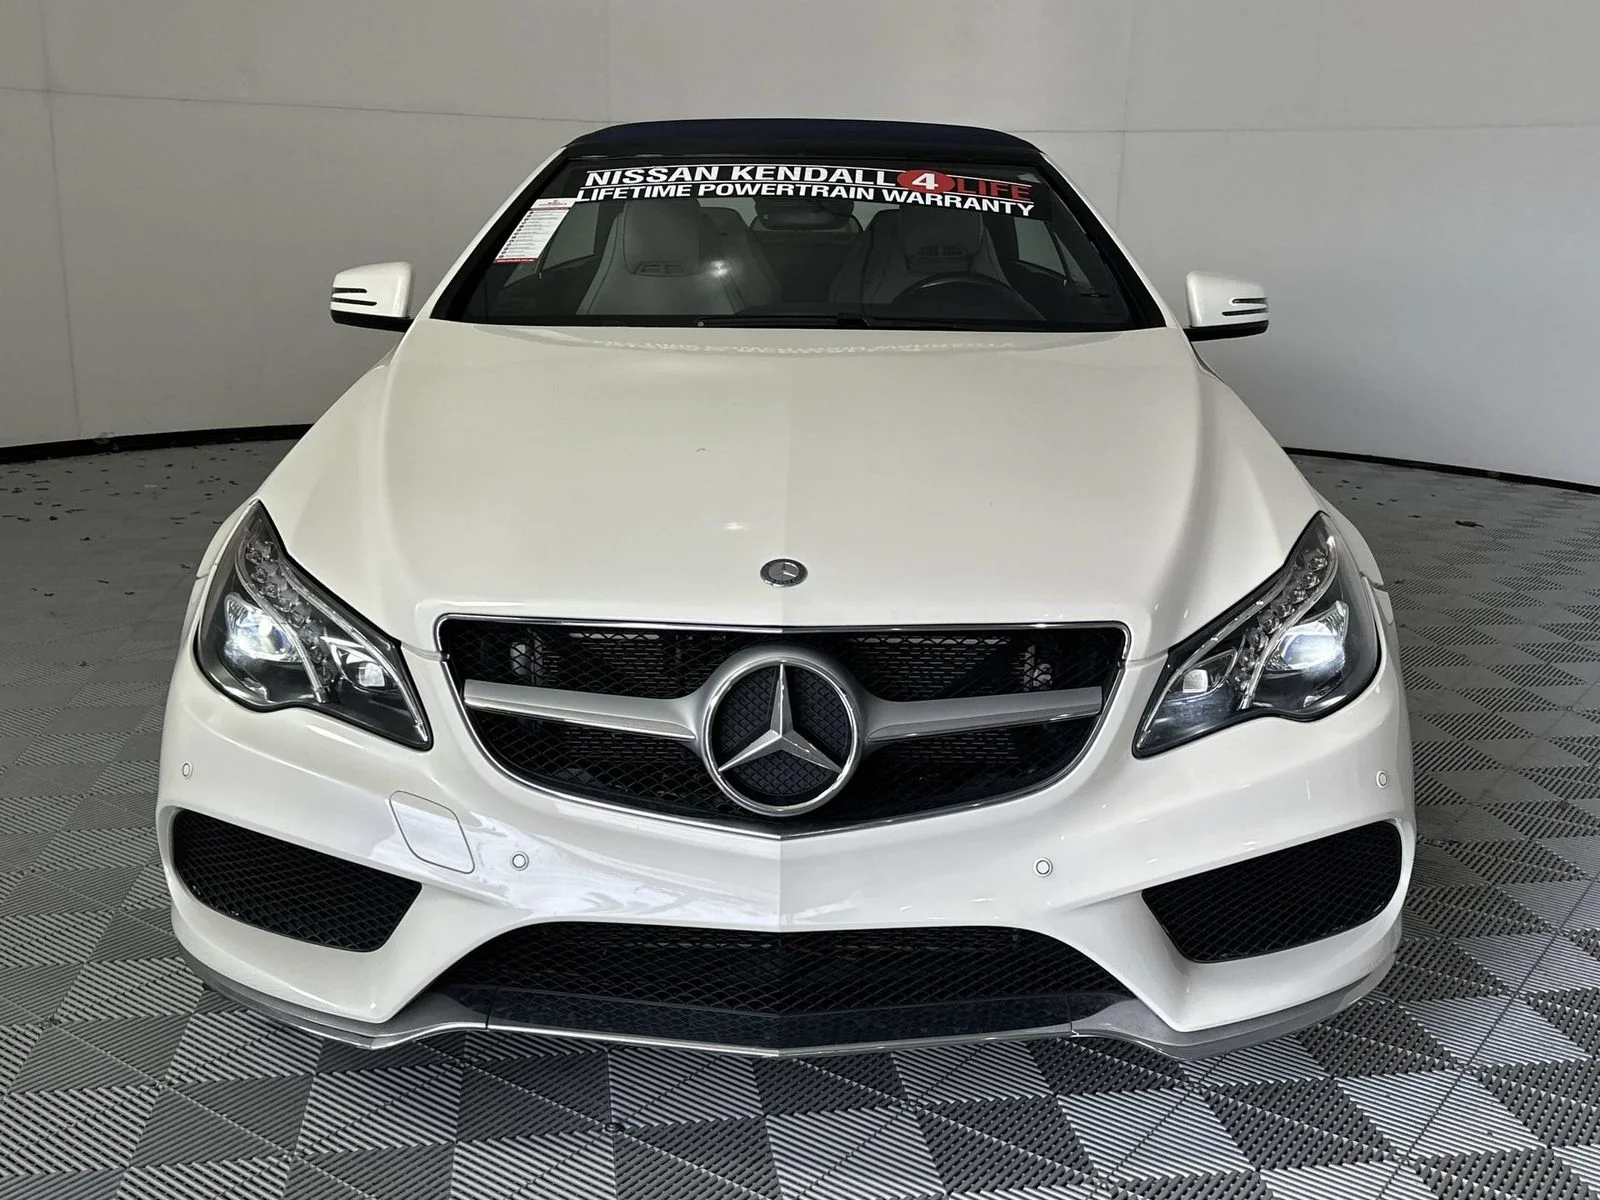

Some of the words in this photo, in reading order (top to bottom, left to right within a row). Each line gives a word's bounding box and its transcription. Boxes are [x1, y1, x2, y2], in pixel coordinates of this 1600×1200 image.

[576, 185, 691, 203] LIFETIME
[698, 183, 875, 200] POWERTRAIN
[881, 190, 1035, 217] WARRANTY
[585, 166, 719, 186] NISSAN
[730, 166, 896, 187] KENDALL
[912, 173, 939, 190] 4
[957, 179, 1031, 200] LIFE
